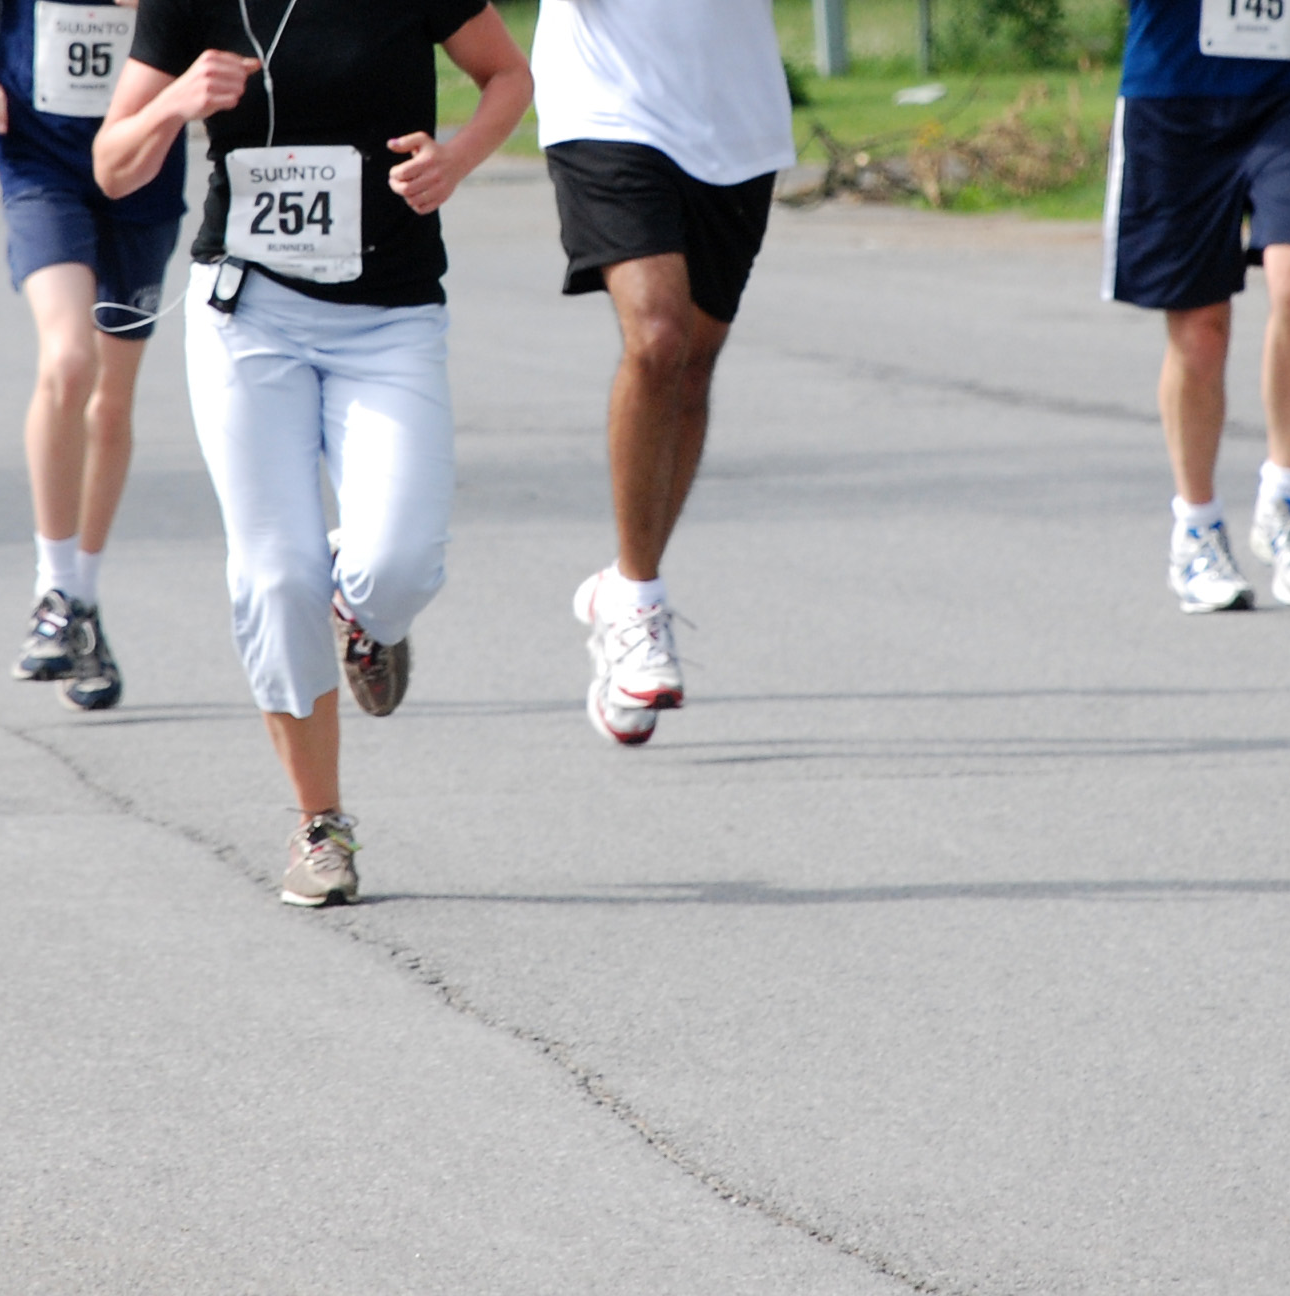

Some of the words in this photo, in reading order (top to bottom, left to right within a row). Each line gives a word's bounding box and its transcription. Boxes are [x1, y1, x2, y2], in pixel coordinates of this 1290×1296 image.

[56, 20, 129, 36] SUUNTO
[67, 41, 114, 78] 95
[250, 165, 337, 183] SUUNTO
[250, 190, 333, 236] 254
[267, 243, 315, 252] RUNNERS
